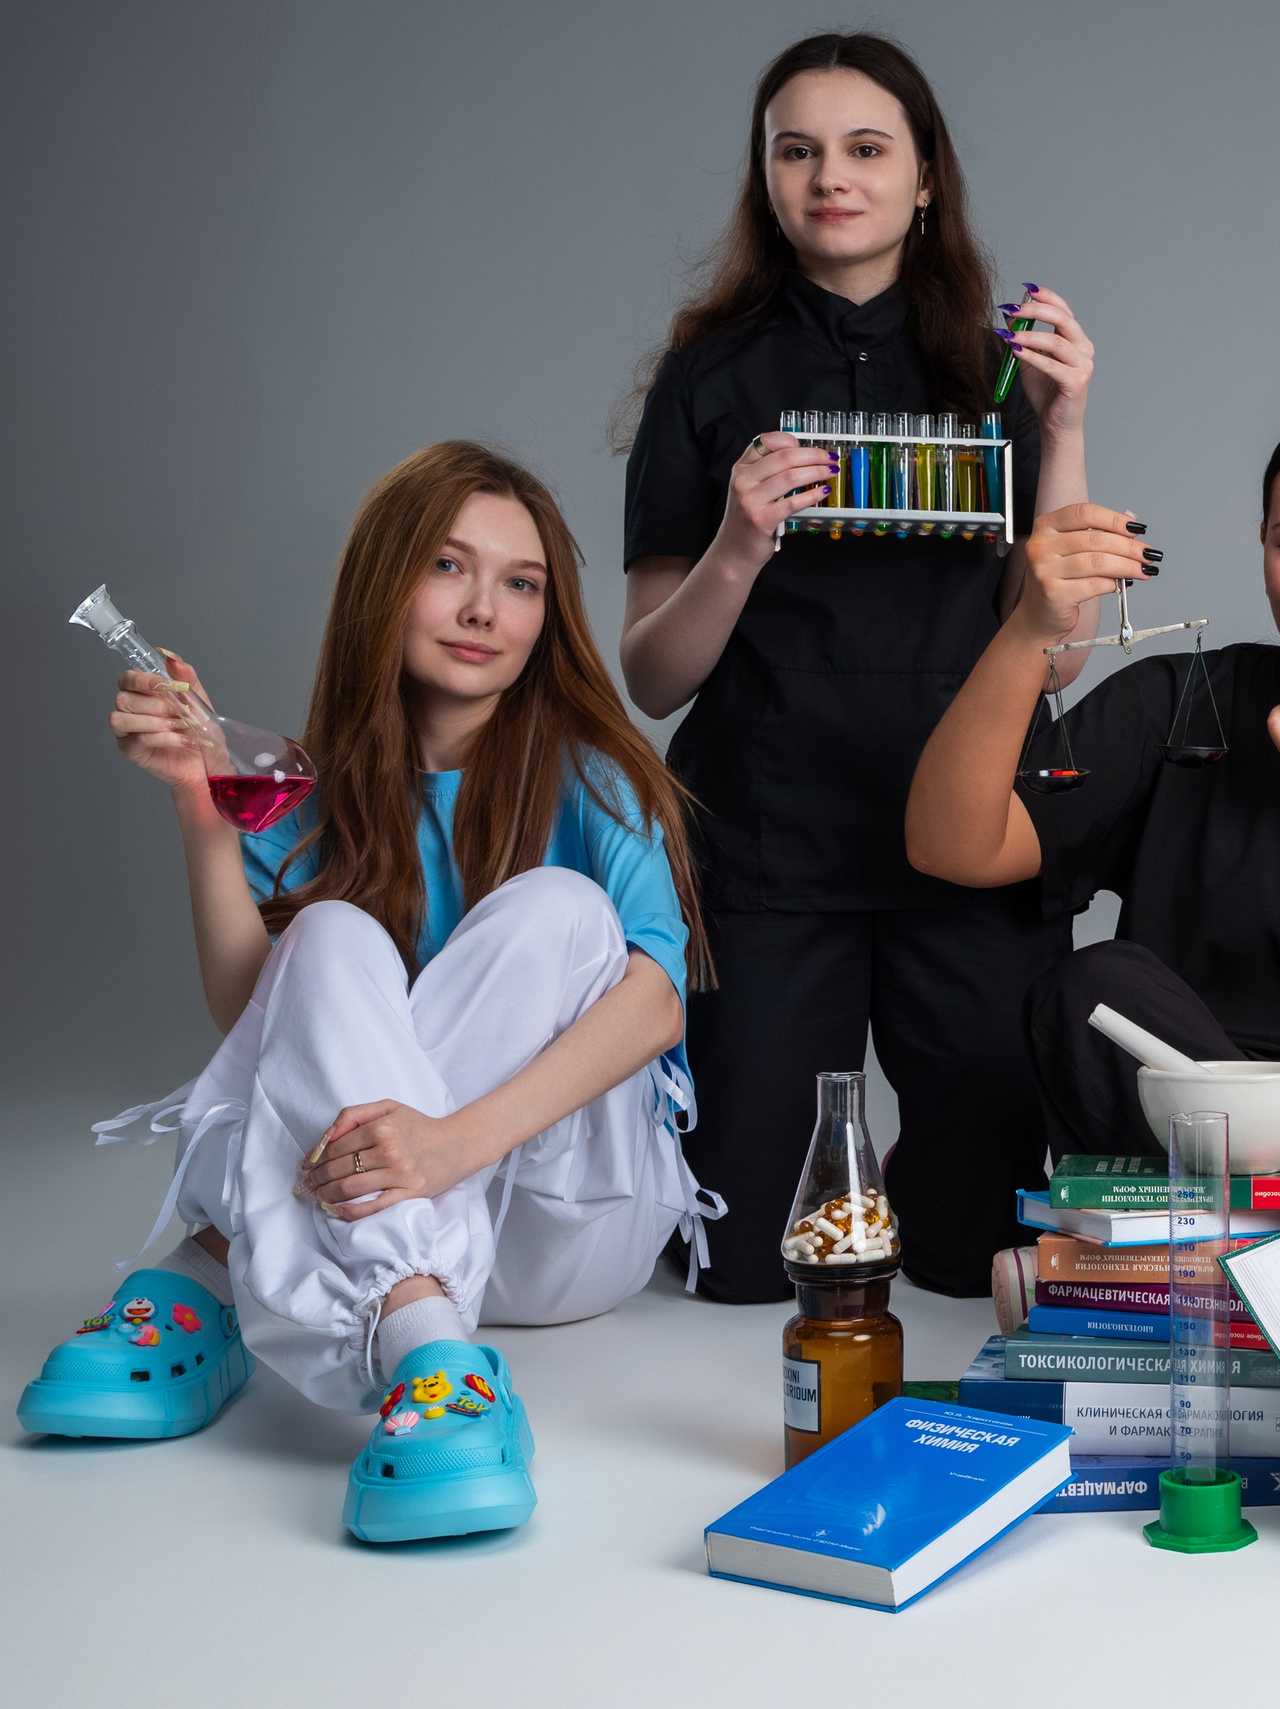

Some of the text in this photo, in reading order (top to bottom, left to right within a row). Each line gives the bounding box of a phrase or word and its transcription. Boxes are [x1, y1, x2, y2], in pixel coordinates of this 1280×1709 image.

[1112, 1185, 1137, 1193] ФОРМ
[1101, 1195, 1155, 1203] ТЕХНОЛОГИИ
[1156, 1195, 1169, 1203] ПО
[1177, 1191, 1195, 1199] 250
[1177, 1217, 1195, 1226] 230
[1177, 1243, 1195, 1252] 210
[1079, 1253, 1102, 1261] ФОРМ
[1103, 1254, 1166, 1262] ЛЕКАРСТВЕННЫХ
[1075, 1263, 1130, 1271] ТЕХНОЛОГИЯ
[1178, 1270, 1196, 1278] 190
[1048, 1283, 1249, 1312] ФАРМАЦЕВТИЧЕСКАЯ БИОТЕХНОЛ
[86, 1315, 114, 1327] TOY
[1178, 1321, 1196, 1330] 150
[1087, 1321, 1154, 1333] БИОТЕХНОЛОГИЯ
[1246, 1333, 1265, 1341] ебное
[1178, 1347, 1196, 1357] 130
[1179, 1374, 1196, 1383] 110
[784, 1381, 817, 1403] LORIDUM
[458, 1396, 489, 1412] TOY
[1179, 1400, 1192, 1409] 90
[1077, 1407, 1163, 1419] КЛИНИЧЕСКАЯ
[905, 1419, 1021, 1447] ФИЗИЧЕСКАЯ
[1109, 1426, 1117, 1435] И
[1180, 1426, 1192, 1435] 70
[913, 1434, 980, 1453] ХИМИЯ
[1180, 1452, 1192, 1461] 50
[1055, 1480, 1147, 1497] ФАРМАЦЕВТ
